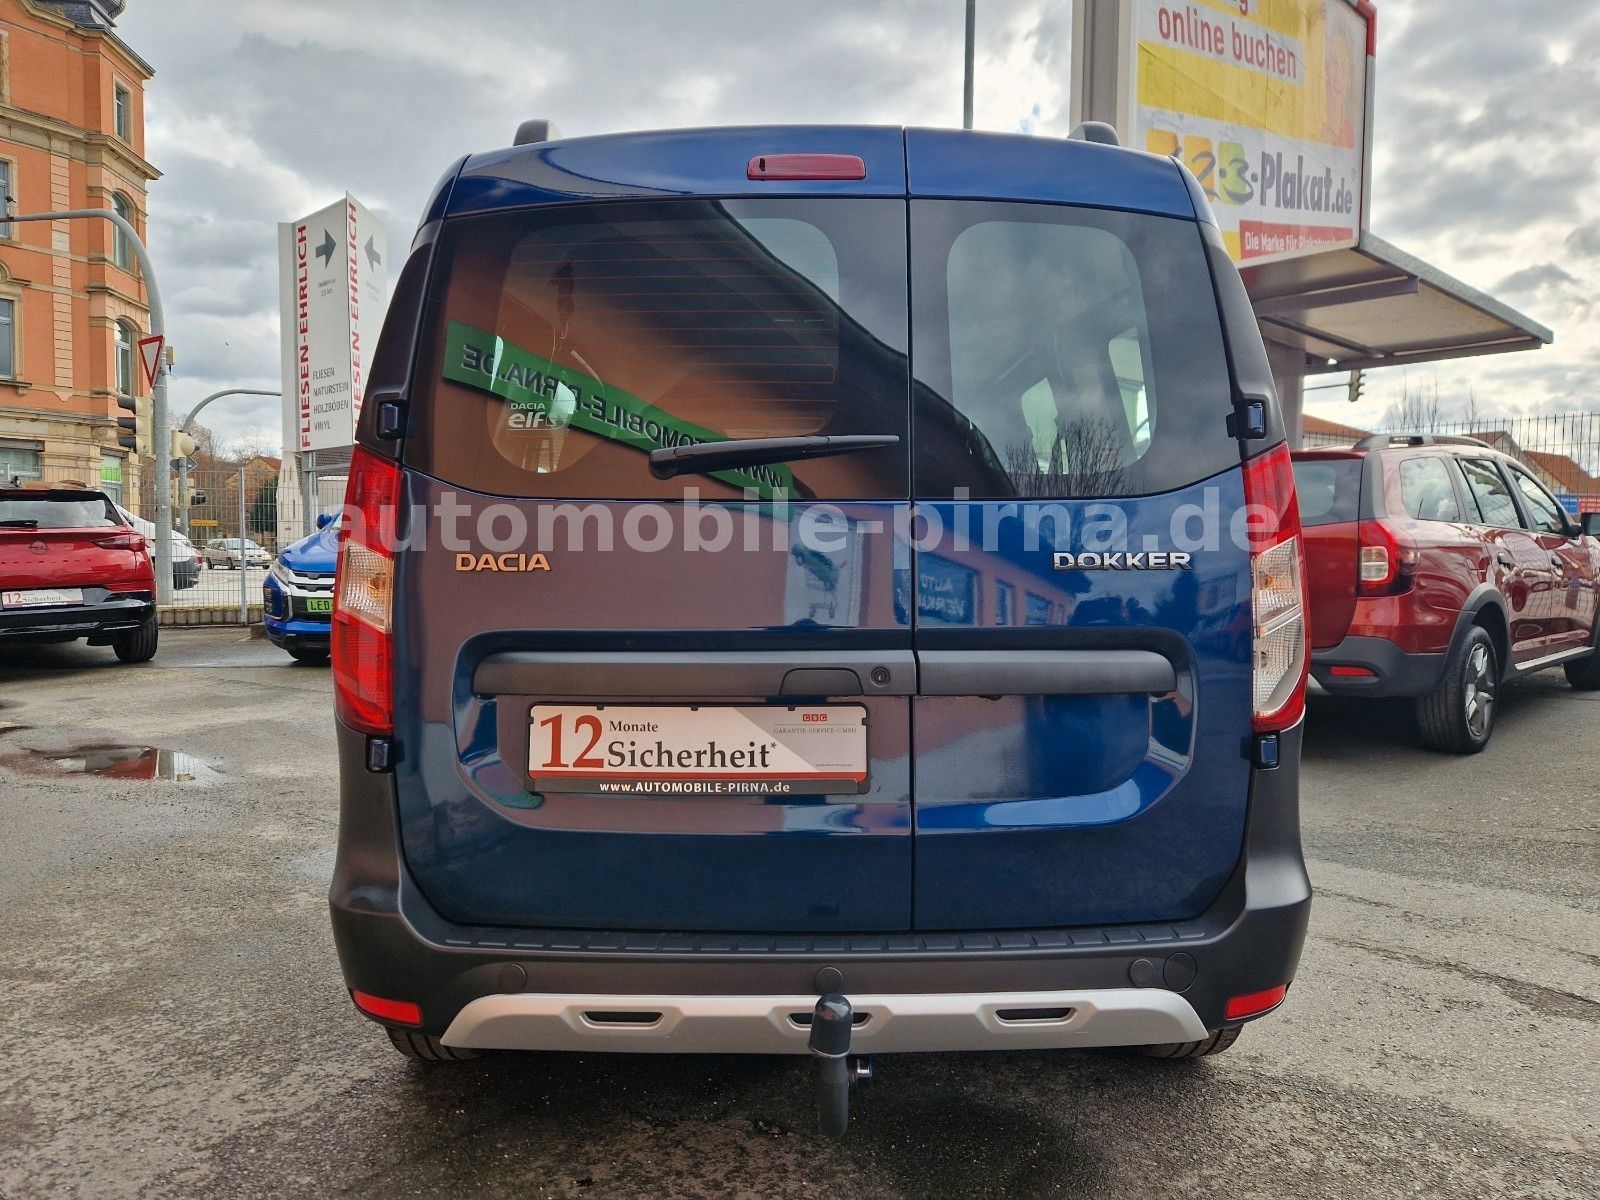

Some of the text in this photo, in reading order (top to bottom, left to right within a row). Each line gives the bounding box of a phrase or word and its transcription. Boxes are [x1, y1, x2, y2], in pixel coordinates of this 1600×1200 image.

[1158, 7, 1297, 79] online buchen
[1245, 232, 1259, 250] Die
[348, 202, 361, 430] IESEN-EHRLICH
[297, 225, 311, 448] FLIESEN-EHRLICH
[312, 367, 335, 380] FLIESEN
[313, 382, 349, 396] NATURSTEIN
[313, 399, 349, 414] HOLZBÖDEN
[510, 402, 546, 410] DACIA
[313, 420, 331, 431] VINYL
[508, 411, 546, 429] elf
[455, 552, 552, 572] DACIA
[1053, 551, 1192, 571] DOKKER
[5, 592, 23, 604] 12
[540, 713, 659, 769] 12 Monate
[600, 781, 790, 793] www.AUTOMOBILE-PIRNA.de
